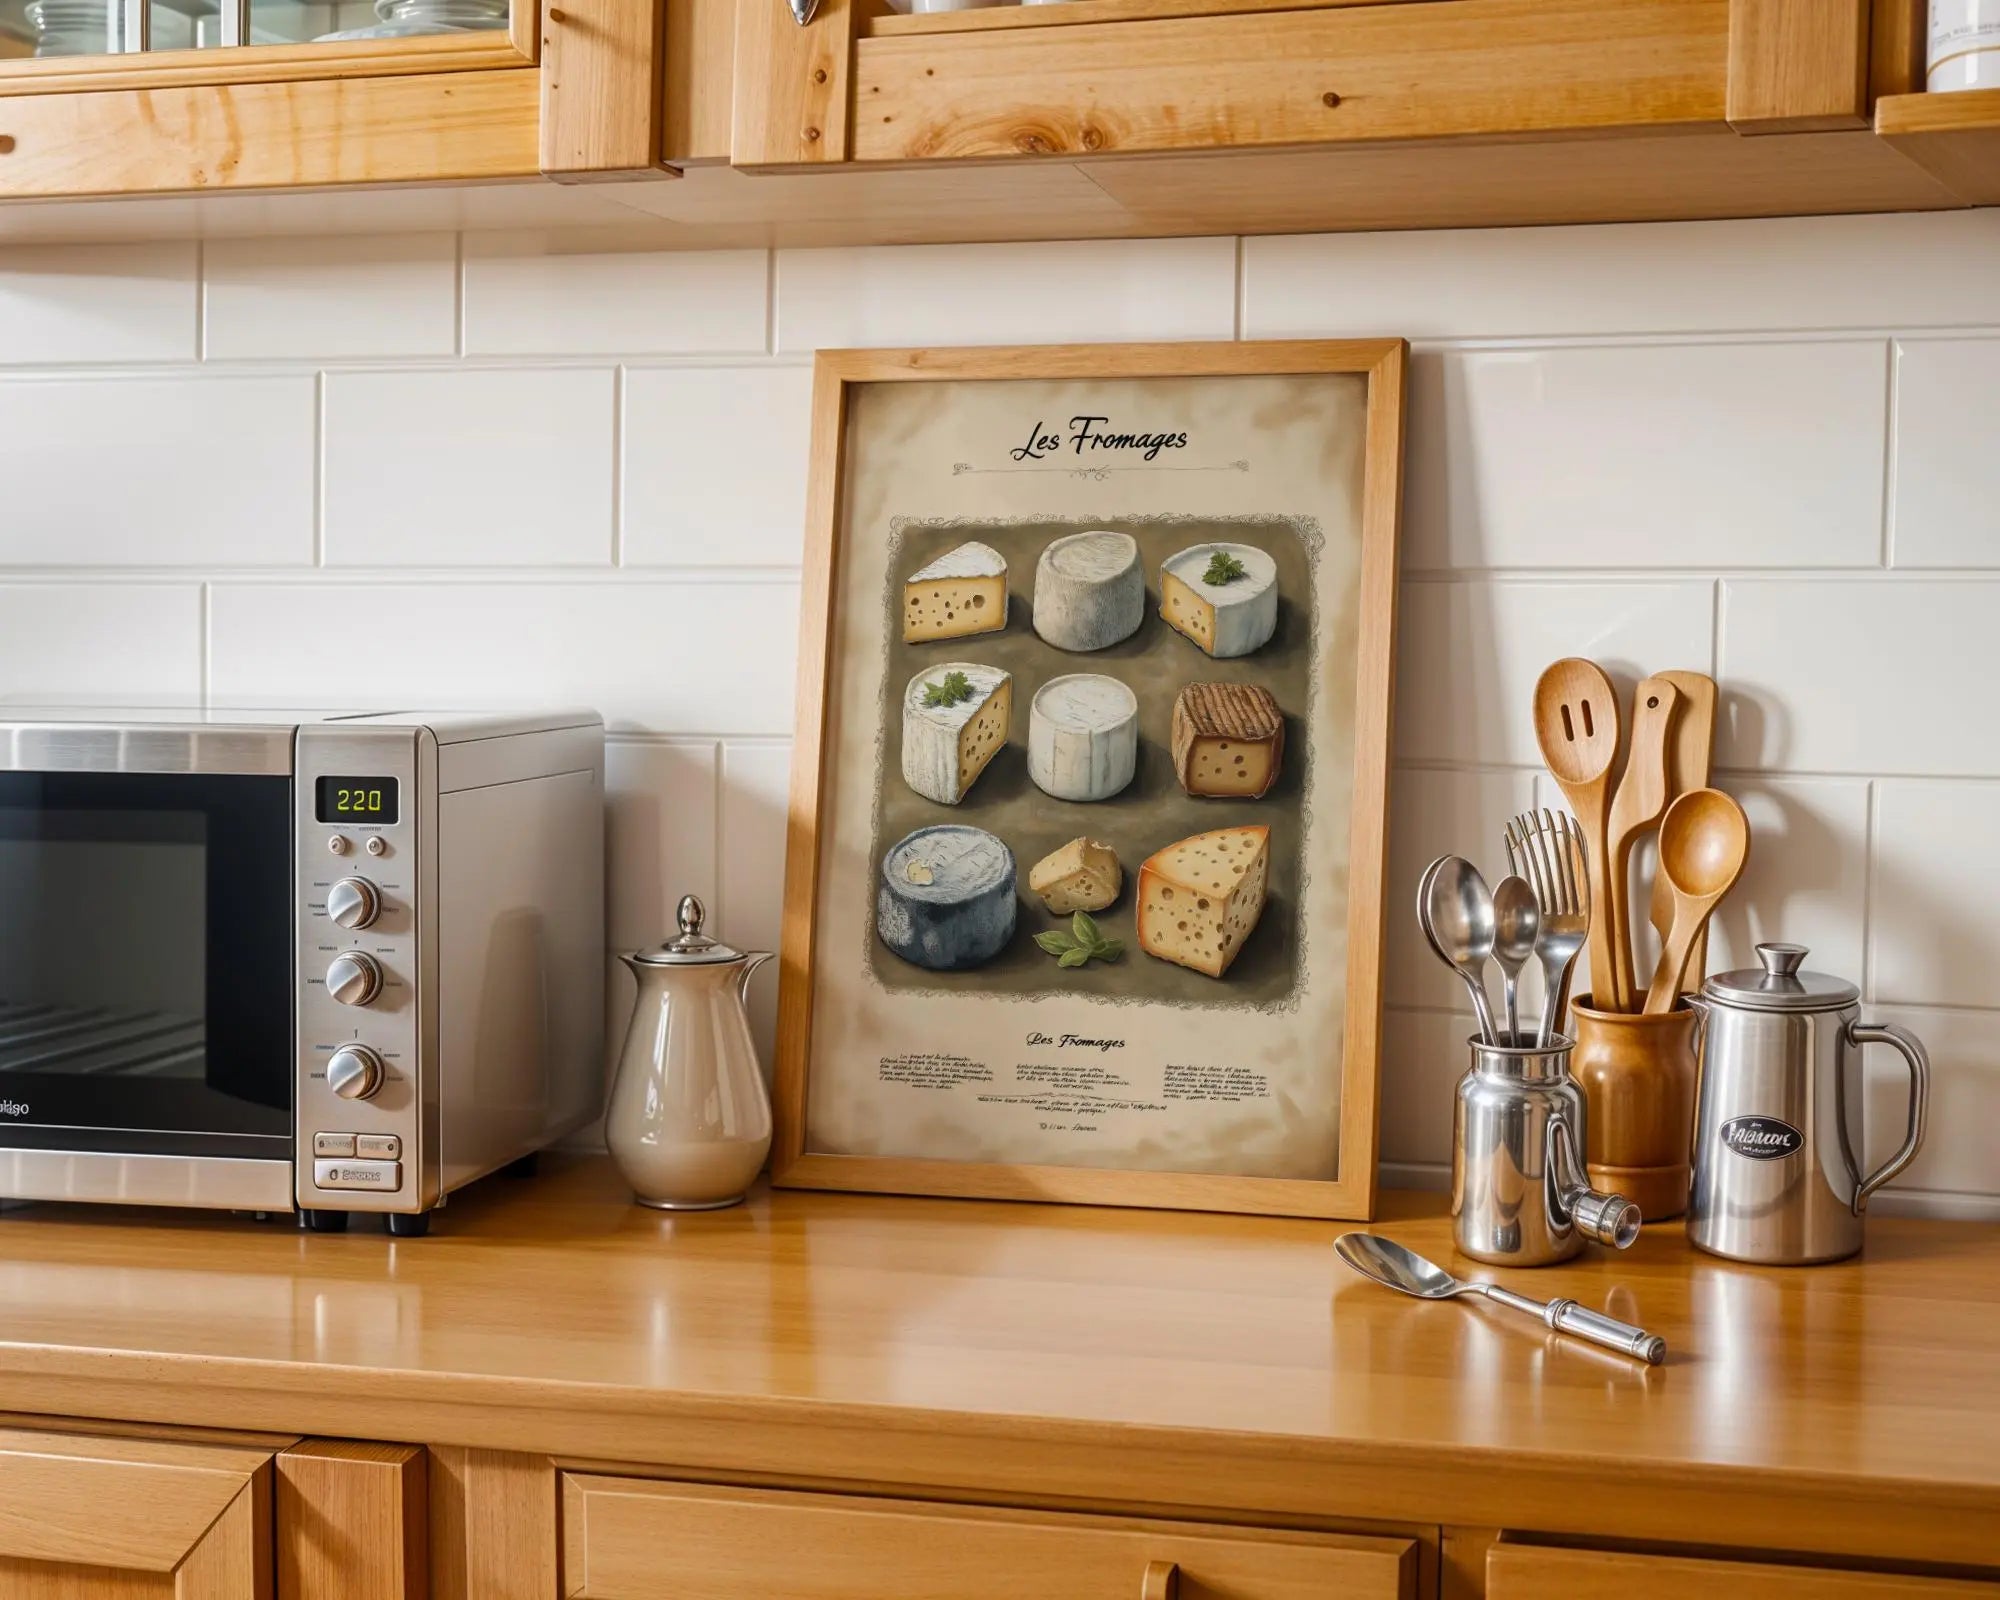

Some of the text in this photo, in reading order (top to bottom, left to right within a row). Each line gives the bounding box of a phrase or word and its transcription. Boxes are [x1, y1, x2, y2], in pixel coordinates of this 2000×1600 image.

[1010, 416, 1188, 461] Les Fromages
[337, 789, 382, 811] 220
[1026, 1032, 1054, 1047] Les
